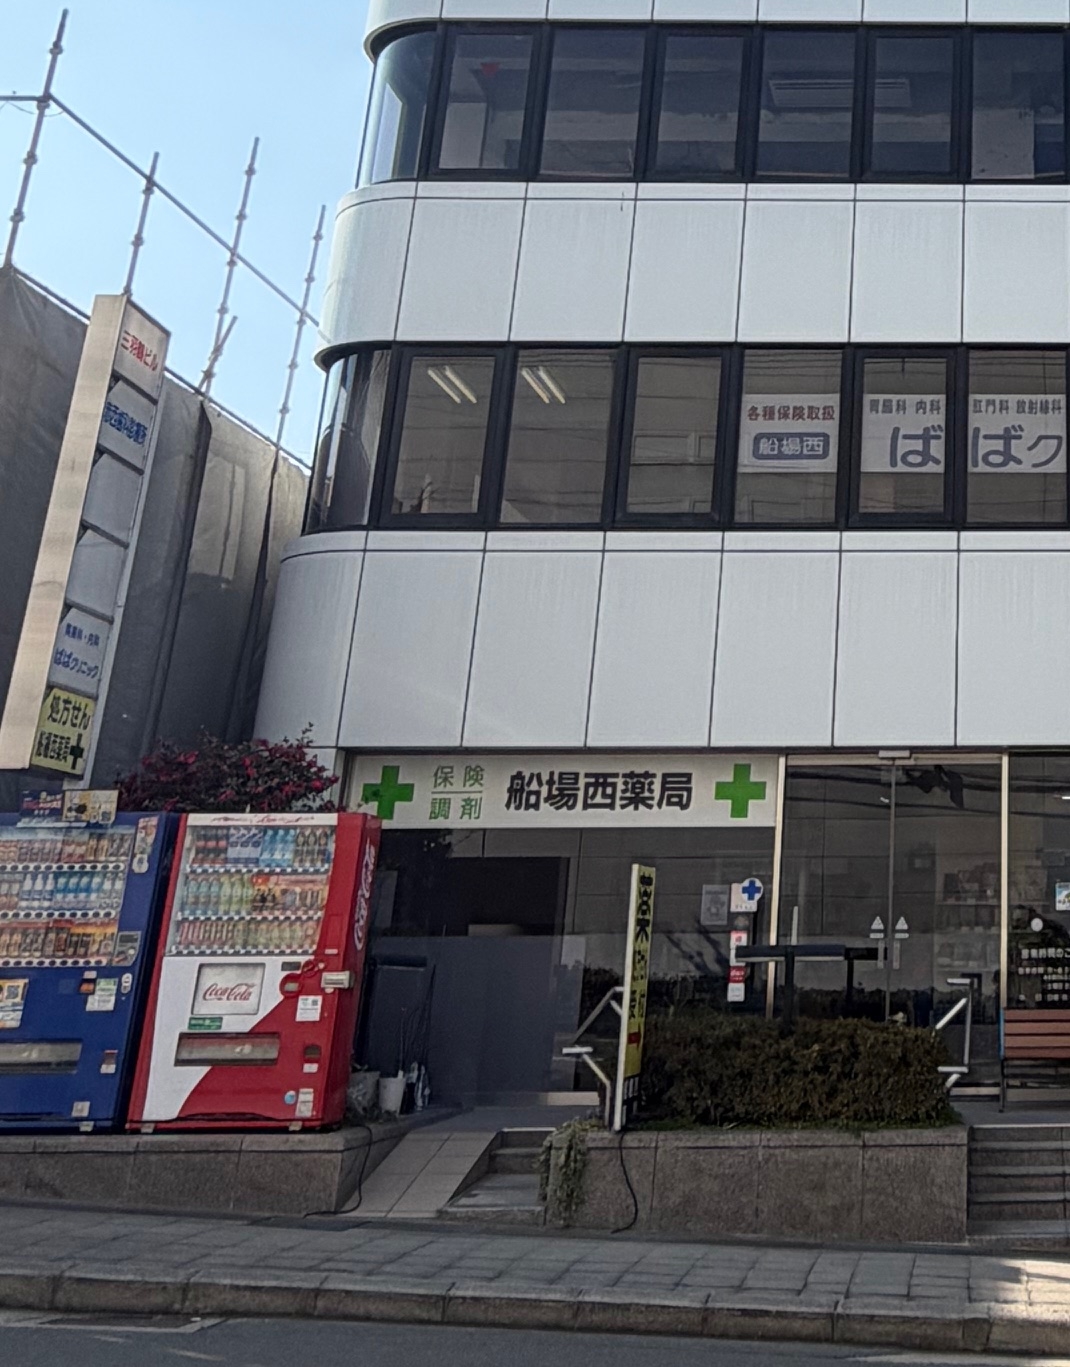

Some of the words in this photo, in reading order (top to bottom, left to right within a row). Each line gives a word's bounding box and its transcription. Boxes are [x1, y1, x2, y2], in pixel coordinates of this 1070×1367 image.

[747, 405, 835, 421] 各種保険取扱
[915, 399, 941, 415] 内科
[758, 436, 824, 455] 船場西
[433, 765, 485, 788] 保険
[505, 771, 693, 811] 船場西薬局
[429, 797, 482, 820] 調剤
